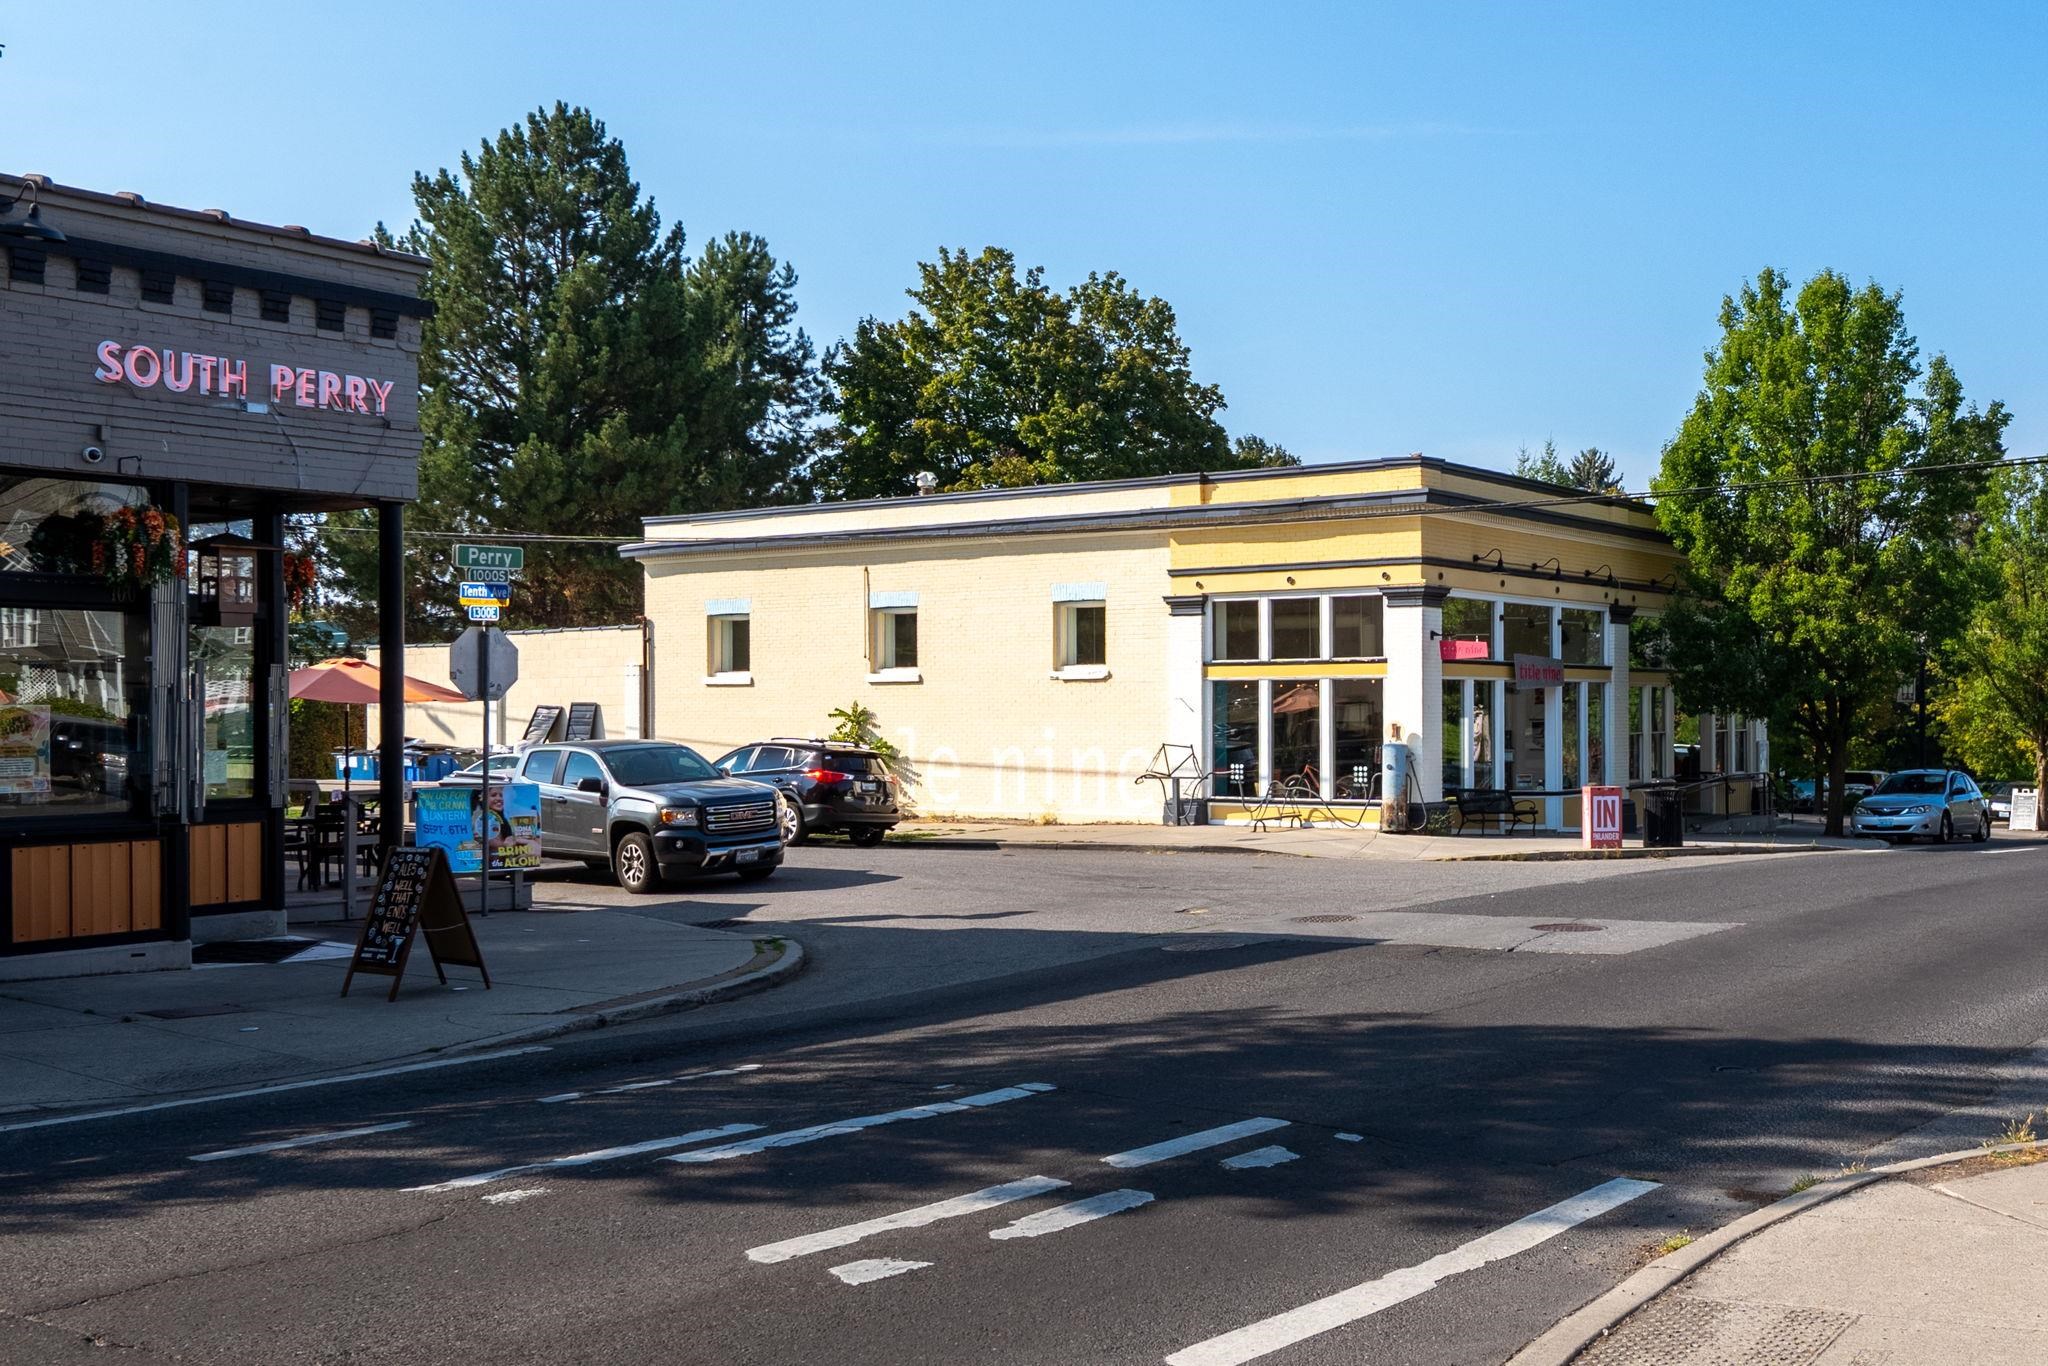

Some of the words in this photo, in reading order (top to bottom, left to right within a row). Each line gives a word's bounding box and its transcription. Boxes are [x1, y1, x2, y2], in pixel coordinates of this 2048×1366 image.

[94, 340, 247, 400] SOUTH
[269, 362, 395, 417] PERRY
[468, 547, 512, 567] Perry
[473, 570, 506, 581] 1000S
[462, 585, 488, 597] Tenth
[492, 587, 507, 598] Ave
[473, 607, 497, 618] 1300E
[1519, 663, 1541, 680] title
[435, 791, 448, 801] US
[449, 791, 468, 802] FOR
[438, 799, 470, 811] CRAWL
[1596, 799, 1616, 828] IN
[448, 824, 469, 836] 6TH
[504, 856, 541, 868] ALOHA
[391, 891, 414, 904] THAT
[382, 920, 402, 935] WELL
